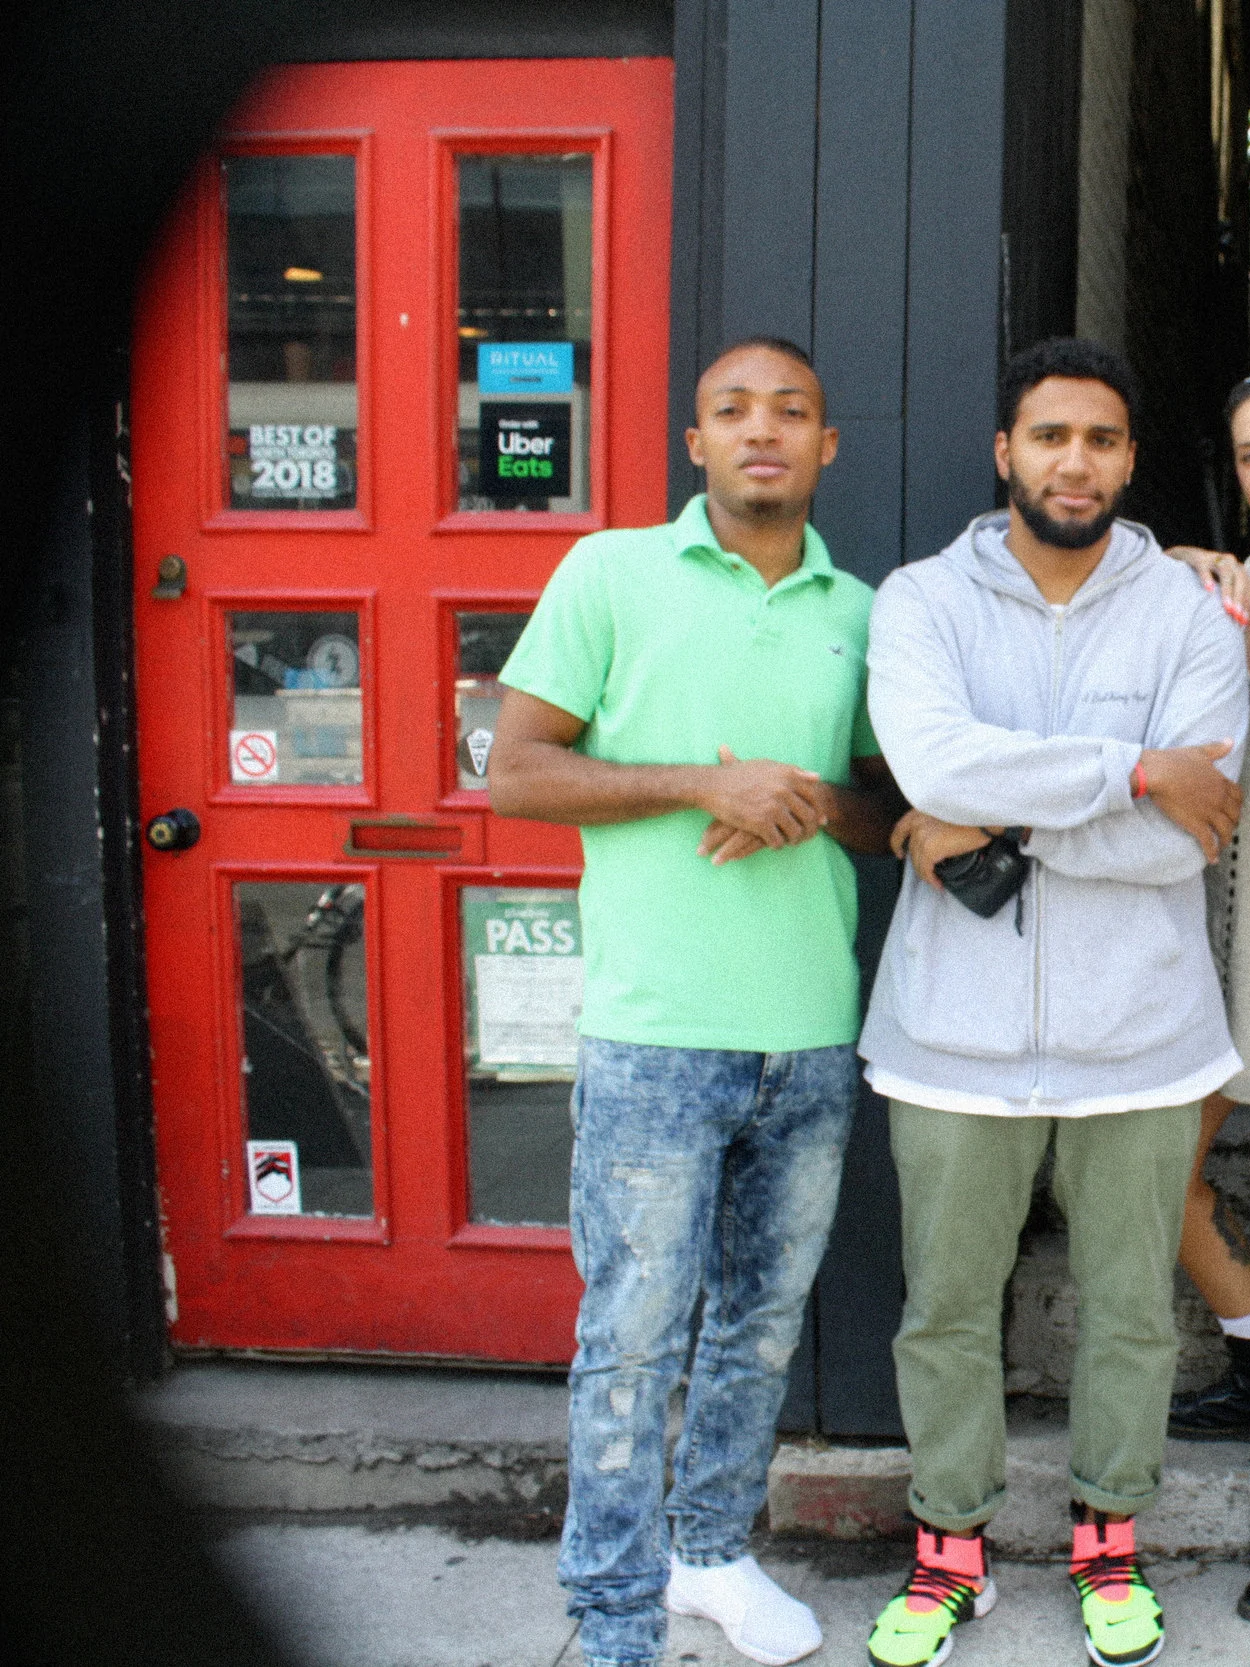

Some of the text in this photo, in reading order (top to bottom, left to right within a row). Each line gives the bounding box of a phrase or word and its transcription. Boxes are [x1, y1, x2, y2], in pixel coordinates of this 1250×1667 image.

[490, 351, 559, 367] RITUAL
[250, 425, 337, 446] BEST OF
[498, 432, 554, 455] Uber
[251, 460, 337, 490] 2018
[498, 455, 553, 478] Eats
[486, 920, 575, 953] PASS
